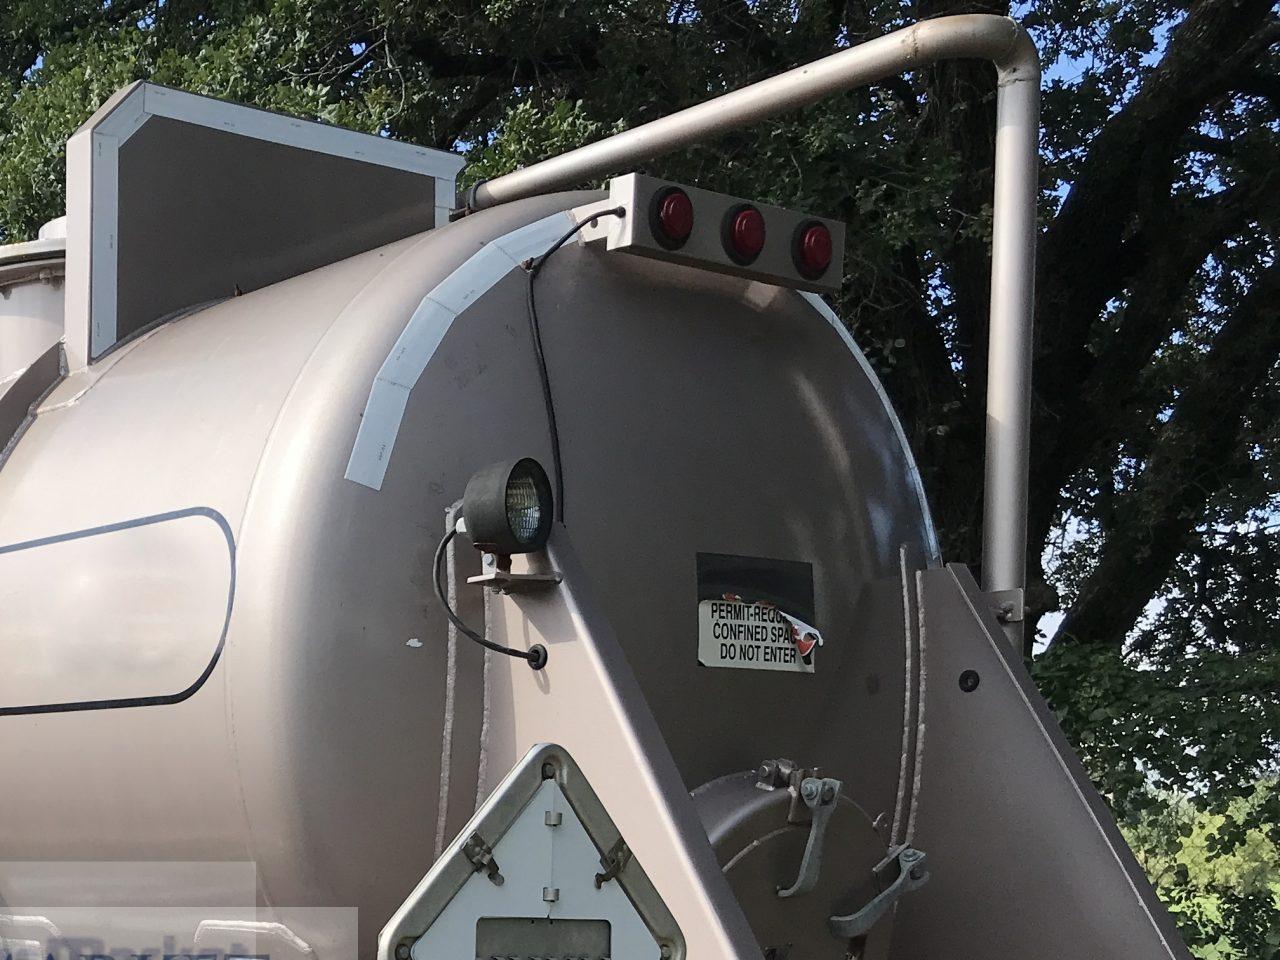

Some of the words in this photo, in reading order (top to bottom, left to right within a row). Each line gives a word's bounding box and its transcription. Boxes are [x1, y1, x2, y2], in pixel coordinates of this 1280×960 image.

[713, 622, 767, 642] CONFINED
[770, 626, 797, 645] SPAC
[720, 643, 736, 660] DO
[739, 644, 761, 661] NOT
[763, 646, 797, 664] ENTER
